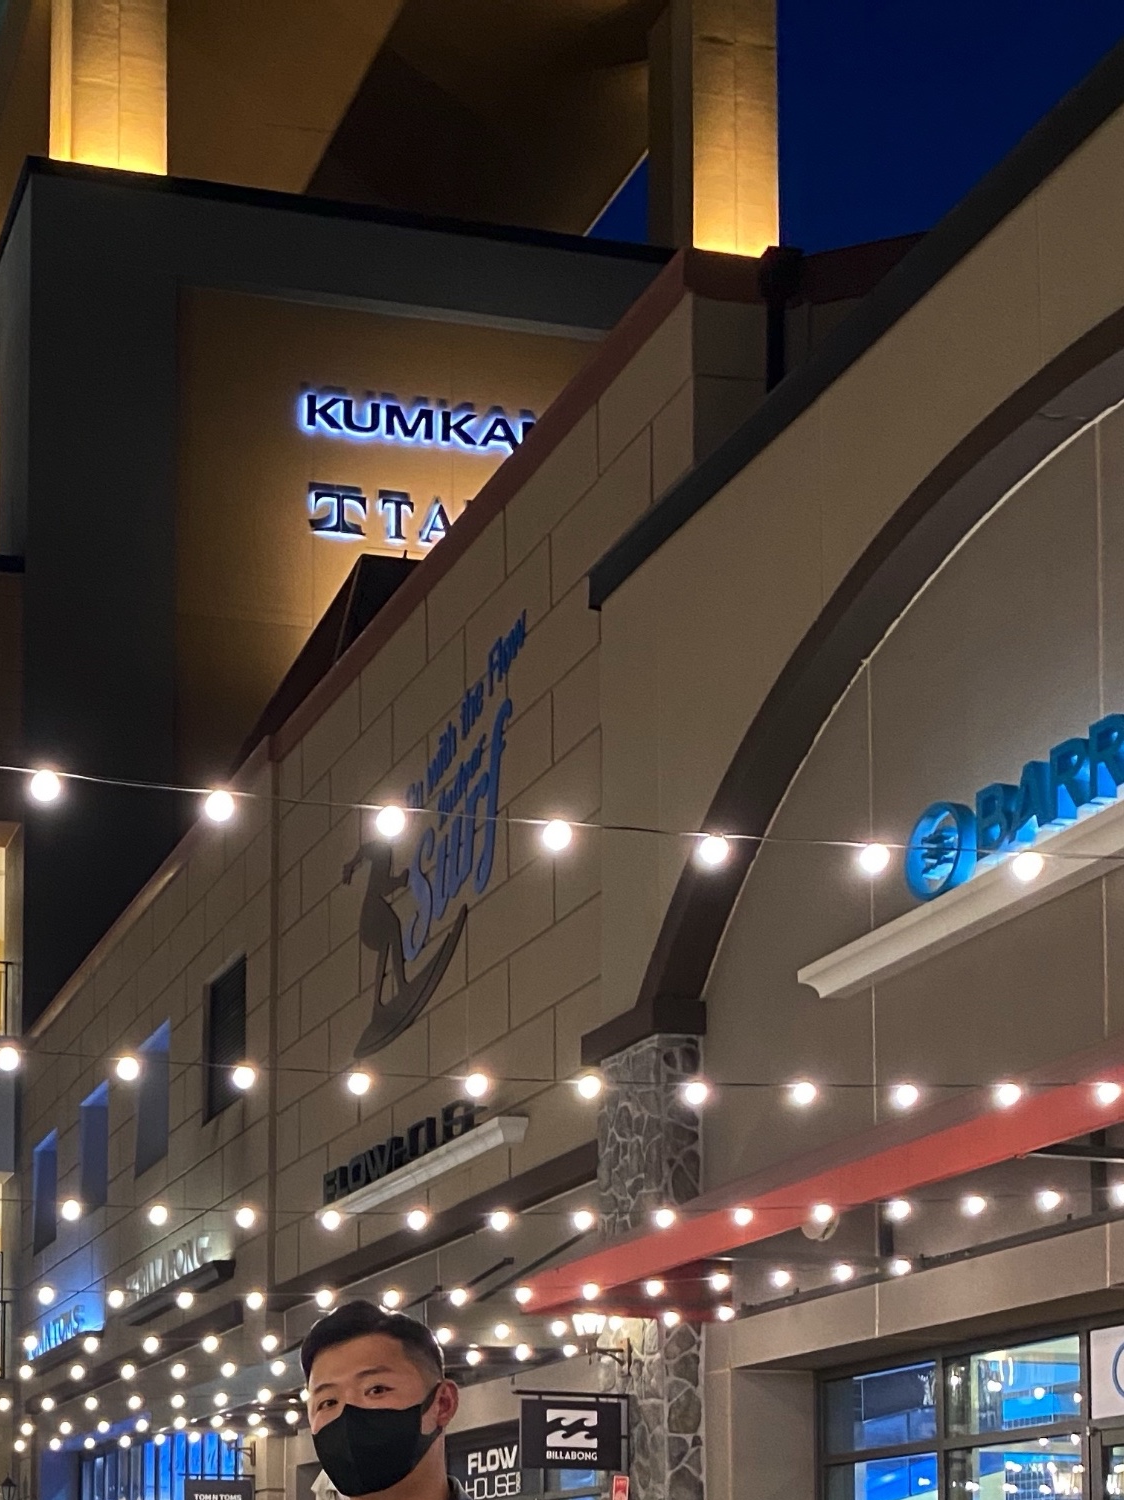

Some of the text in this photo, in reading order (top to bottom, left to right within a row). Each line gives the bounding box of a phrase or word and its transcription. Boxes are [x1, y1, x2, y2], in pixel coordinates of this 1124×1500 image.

[305, 393, 537, 451] KUMKA
[460, 681, 484, 740] the
[487, 608, 527, 697] Flow
[402, 697, 513, 963] Surf
[467, 1445, 518, 1475] FLOW
[545, 1450, 598, 1461] BILLABONG
[465, 1472, 517, 1500] HOUSE
